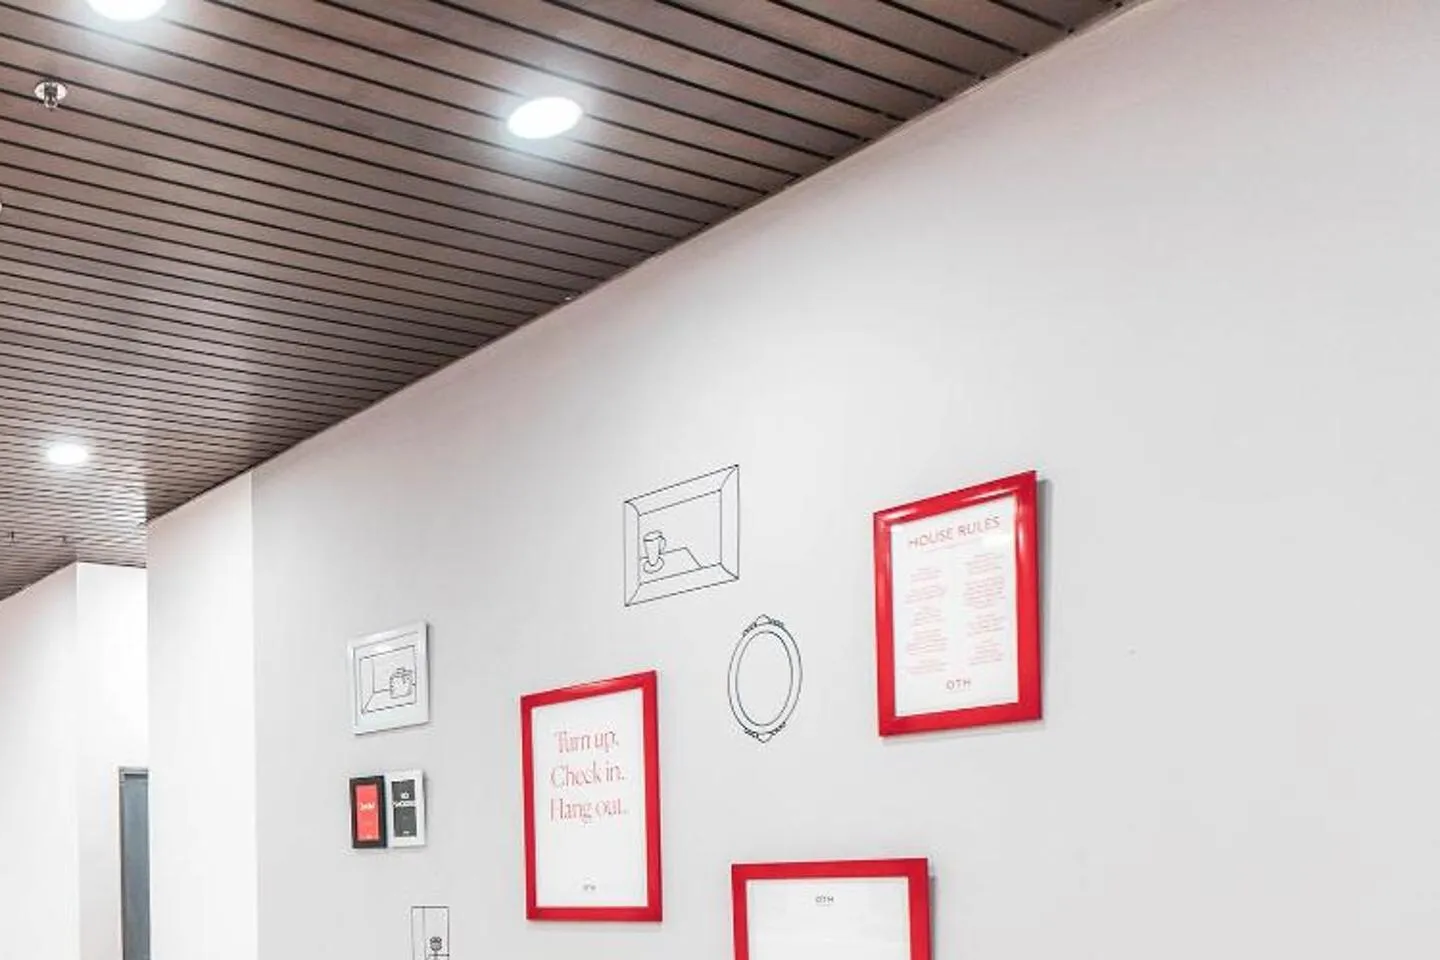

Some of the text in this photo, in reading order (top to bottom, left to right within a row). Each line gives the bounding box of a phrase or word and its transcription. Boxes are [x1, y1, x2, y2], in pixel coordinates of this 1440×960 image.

[908, 528, 954, 548] HOUSE
[957, 515, 1000, 536] RULES
[945, 678, 972, 691] OTH
[554, 730, 620, 753] Turn up.
[550, 760, 626, 788] Check in.
[550, 797, 593, 826] Hang
